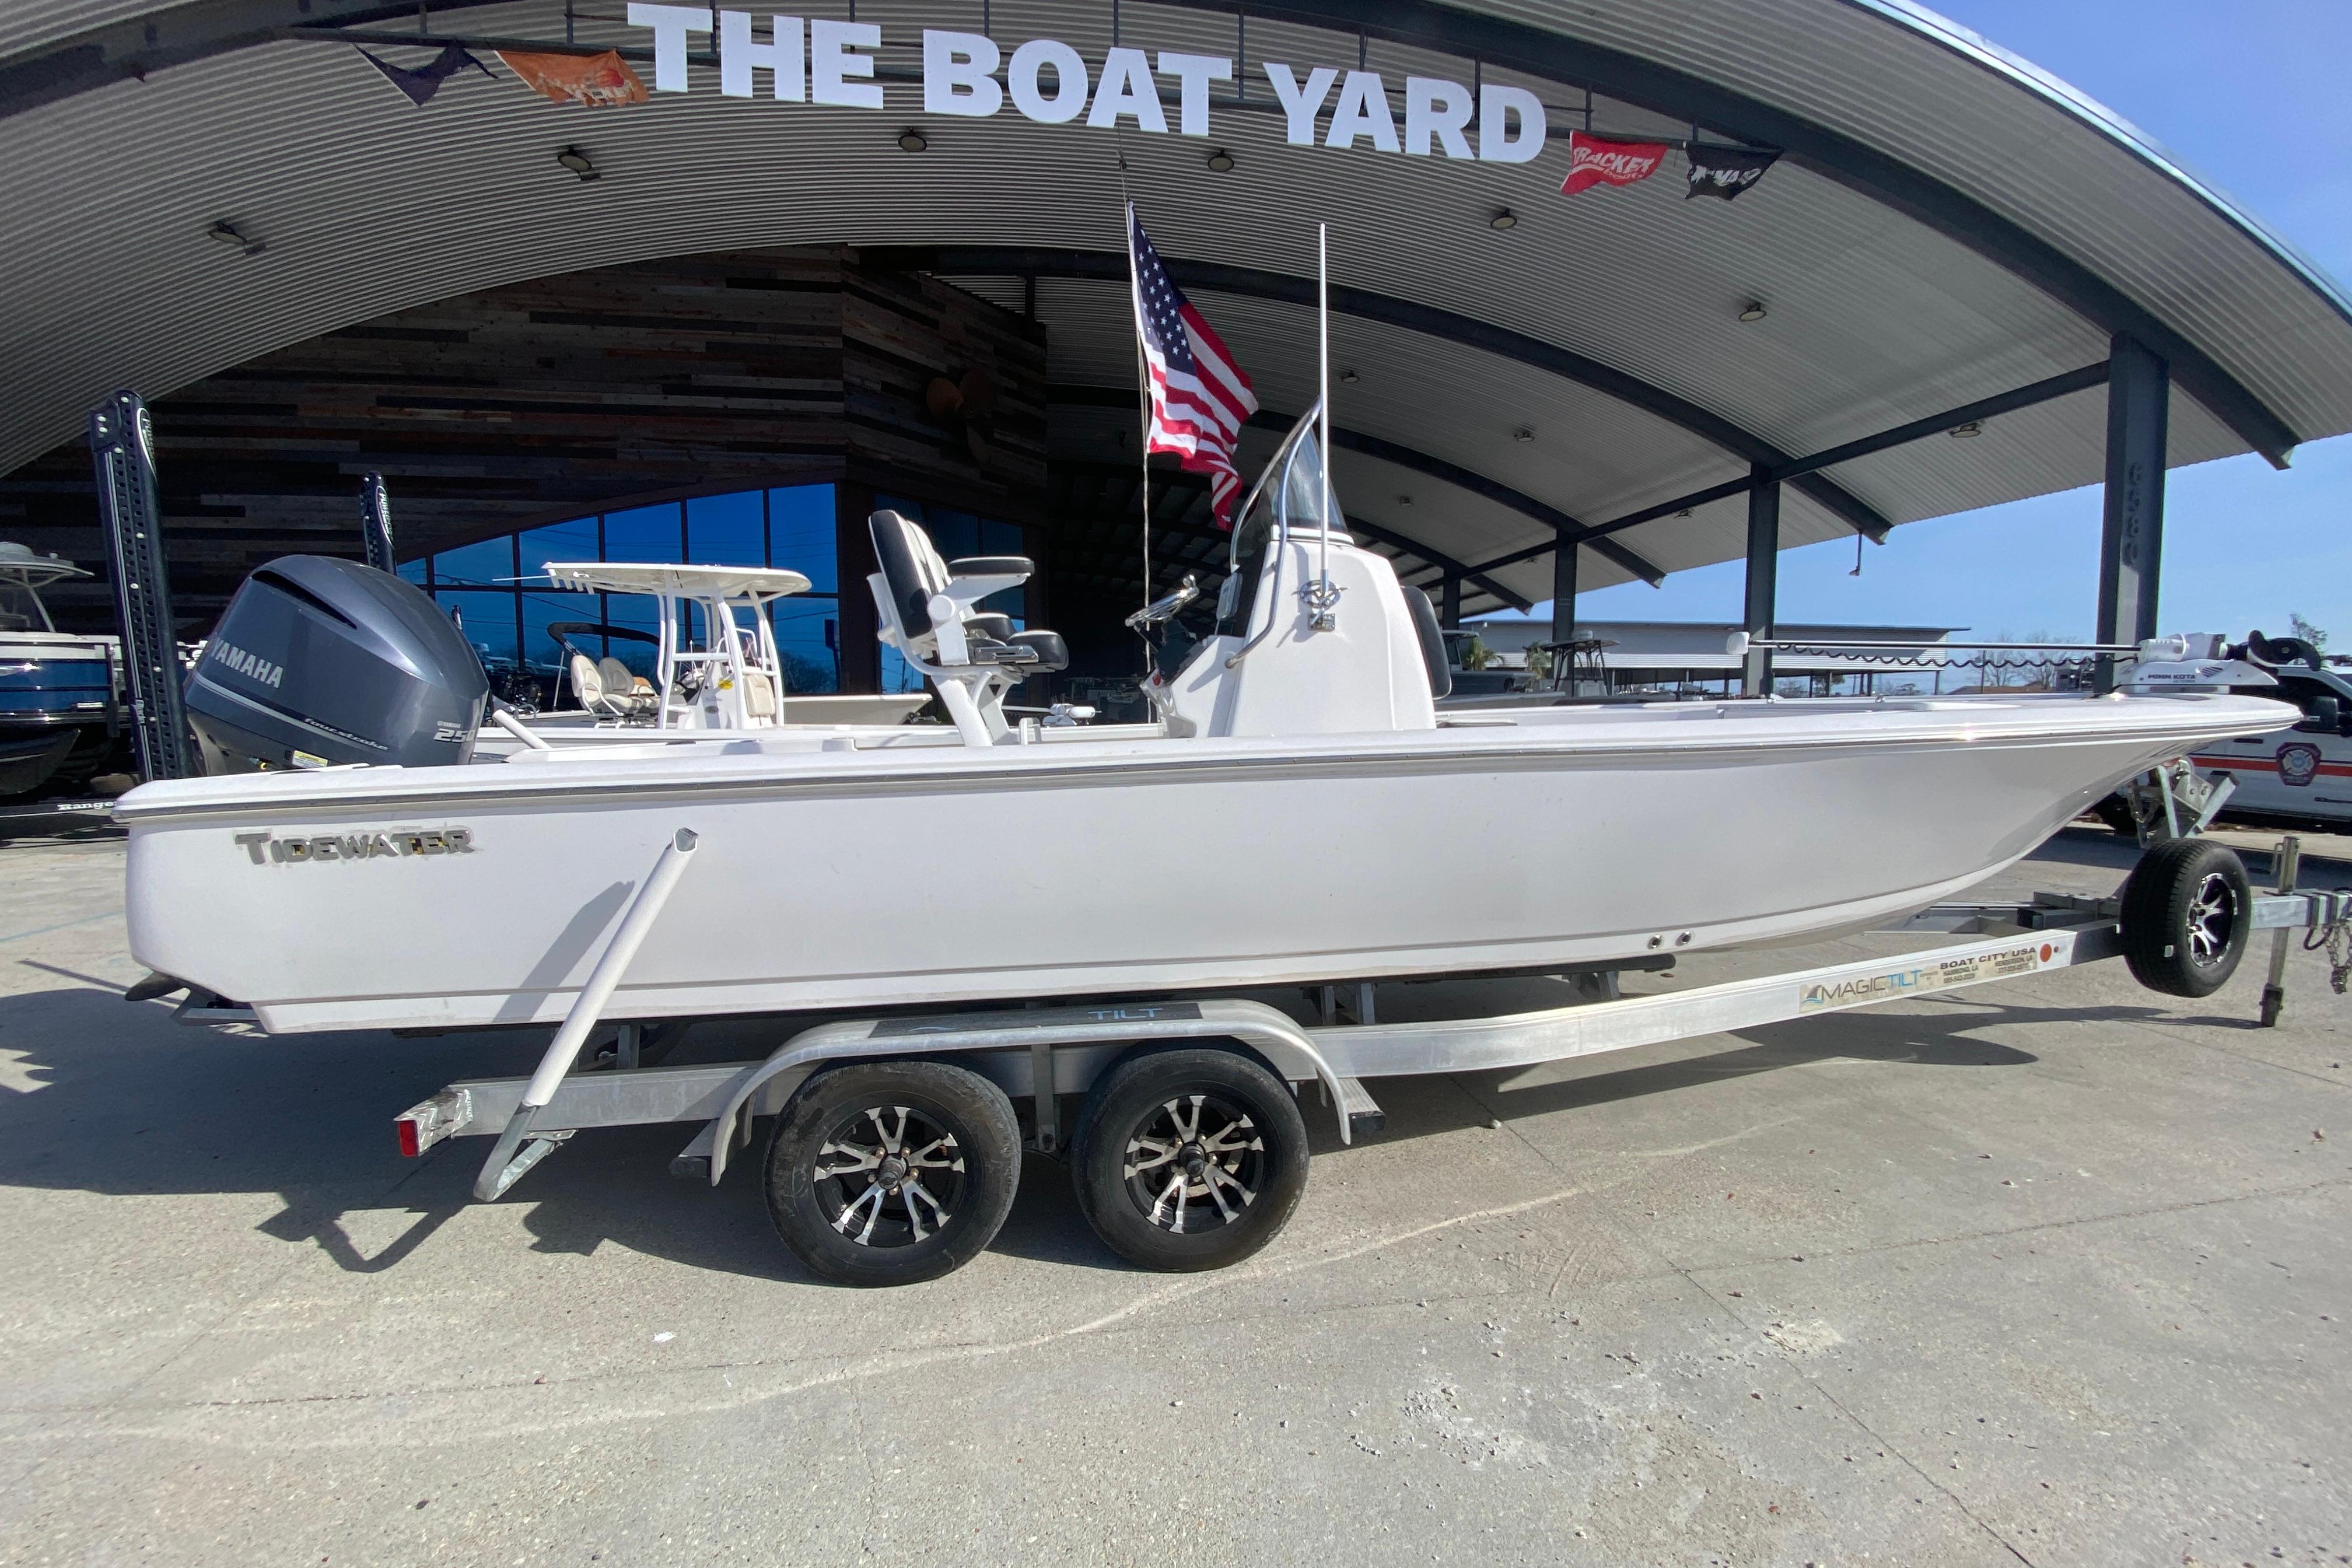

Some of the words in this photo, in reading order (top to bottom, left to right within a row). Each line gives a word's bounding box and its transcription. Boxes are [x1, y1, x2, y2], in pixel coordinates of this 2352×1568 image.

[627, 2, 884, 110] THE
[923, 29, 1233, 136] BOAT
[1263, 62, 1546, 163] YARD
[211, 637, 284, 688] YAMAHA
[304, 718, 388, 751] fourstroke
[434, 728, 475, 743] 250
[235, 830, 476, 864] TIDEWATER
[1940, 958, 1975, 970] BOAT
[1979, 951, 2008, 963] CITY
[2013, 947, 2036, 957] USA
[1088, 1007, 1163, 1020] TILT
